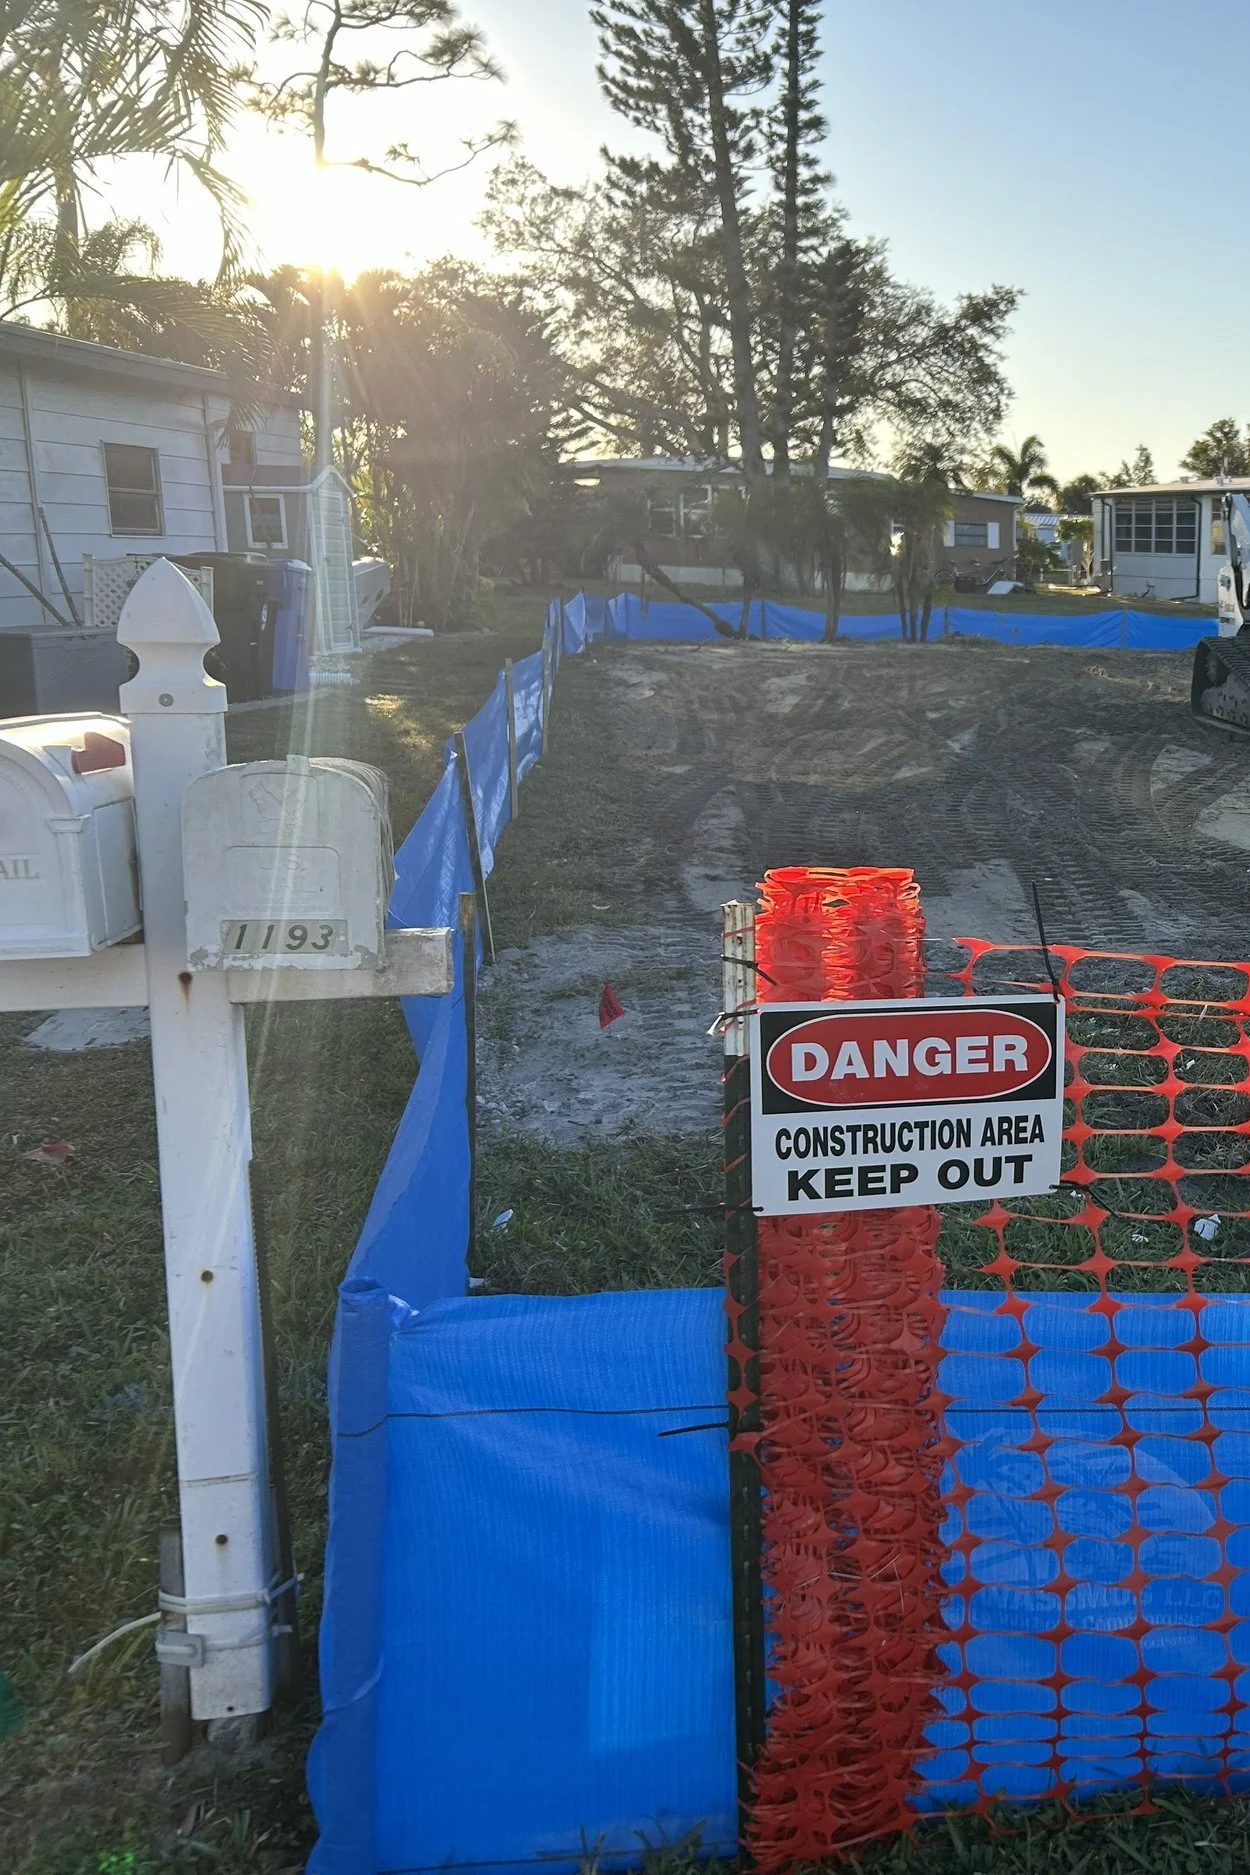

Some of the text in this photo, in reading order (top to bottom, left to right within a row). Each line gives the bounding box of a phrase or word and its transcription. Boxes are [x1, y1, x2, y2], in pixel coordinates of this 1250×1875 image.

[234, 924, 334, 951] 1193
[790, 1034, 1029, 1082] DANGER
[775, 1114, 1045, 1160] CONSTRUCTION AREA
[787, 1154, 1033, 1202] KEEP OUT
